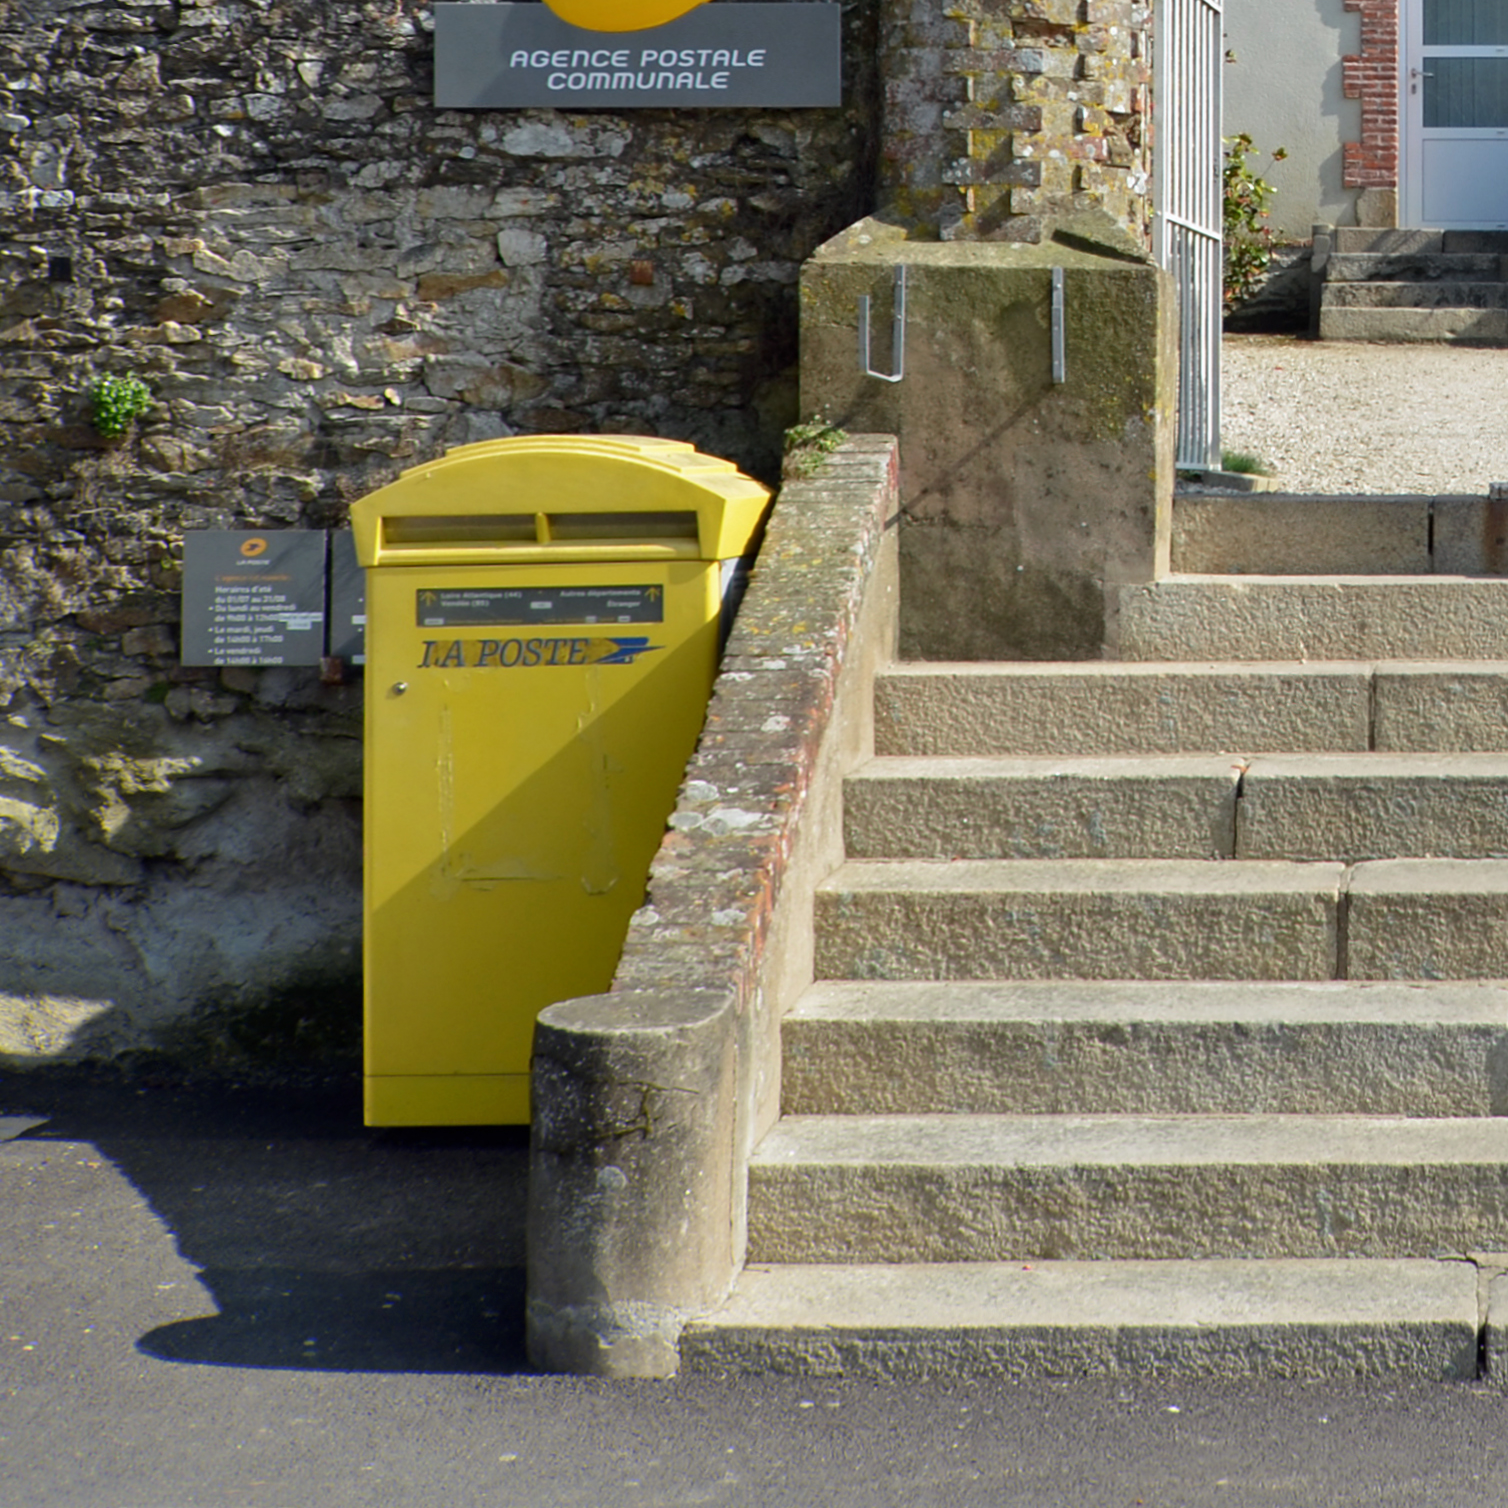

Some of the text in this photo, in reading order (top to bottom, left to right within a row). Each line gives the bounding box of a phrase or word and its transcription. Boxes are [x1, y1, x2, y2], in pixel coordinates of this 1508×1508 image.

[510, 48, 766, 68] AGENCE POSTALE
[547, 71, 731, 91] COMMUNALE
[416, 637, 591, 668] LA POSTE
